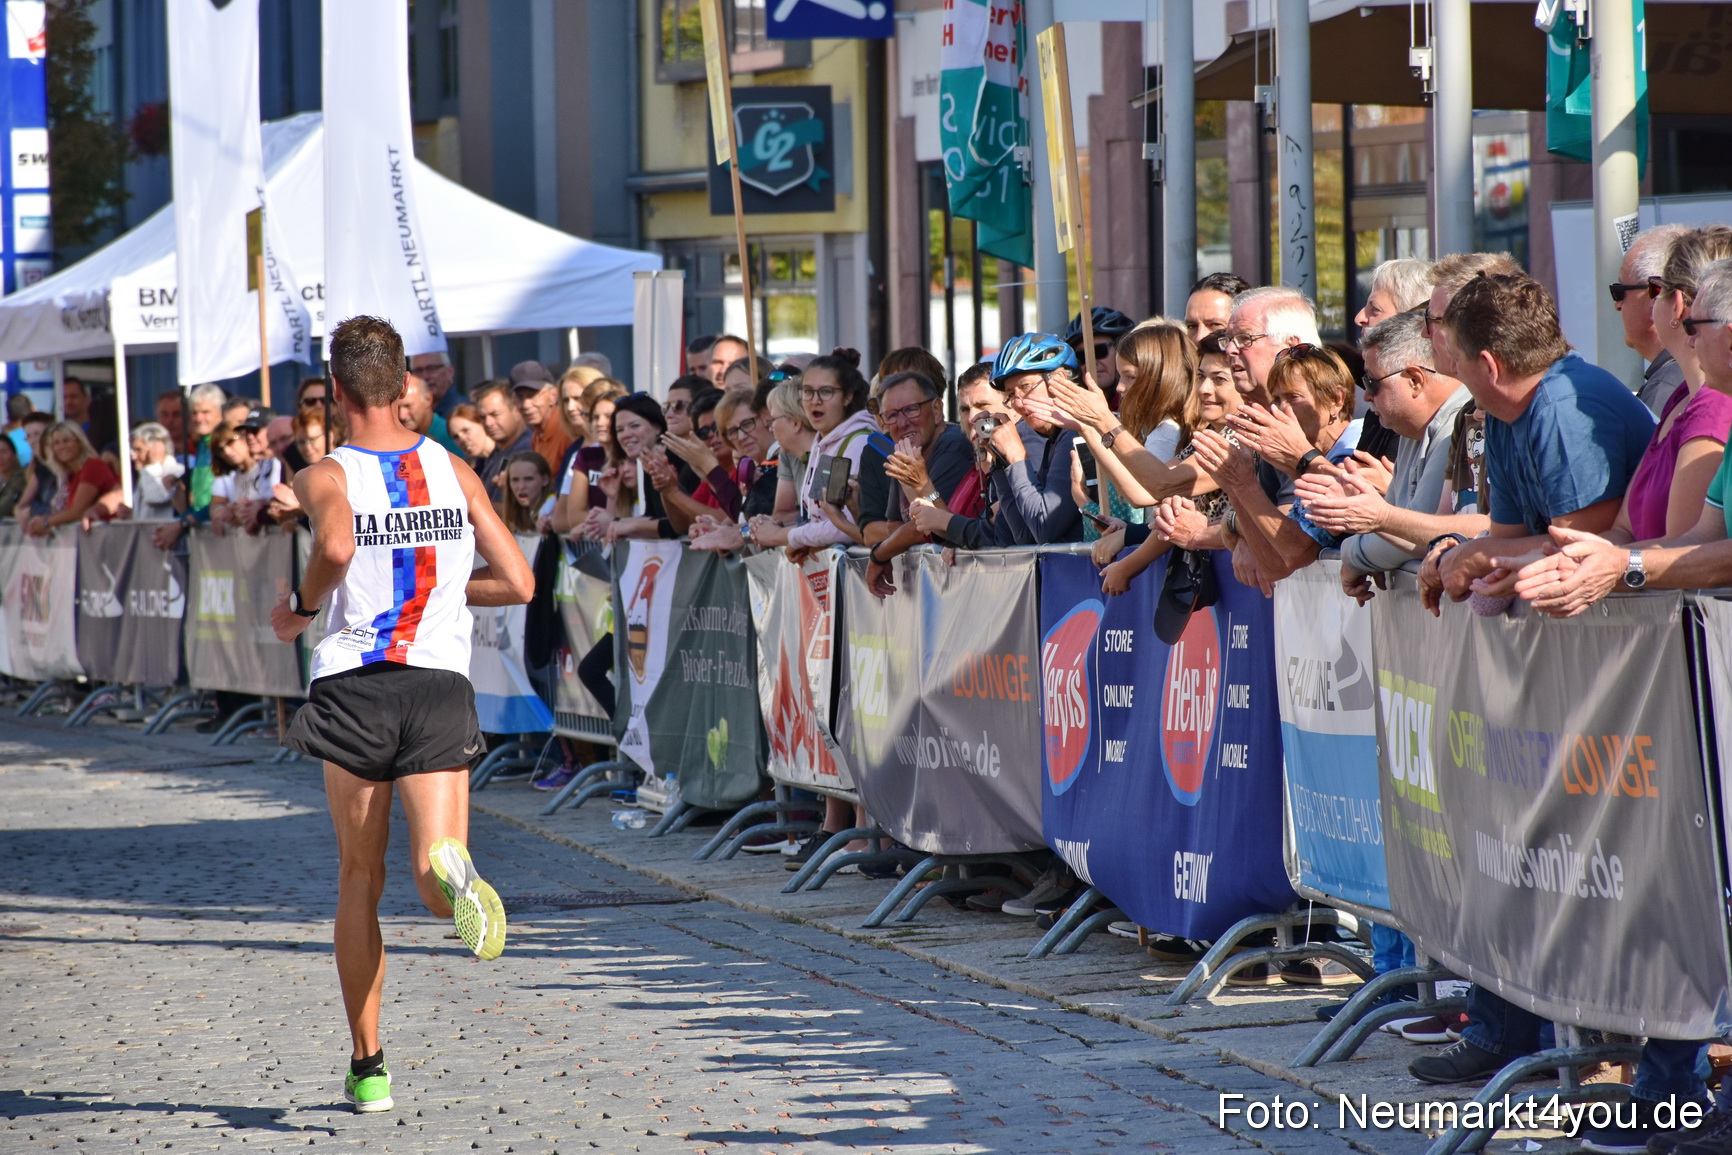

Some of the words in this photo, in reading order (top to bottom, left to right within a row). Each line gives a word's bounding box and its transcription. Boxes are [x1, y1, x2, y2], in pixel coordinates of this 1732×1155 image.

[754, 121, 796, 173] G2
[388, 144, 422, 267] NEUMARKT
[411, 270, 440, 338] PARTL
[354, 514, 378, 535] LA
[384, 508, 464, 533] CARRERA
[355, 532, 411, 547] TRITEAM
[1104, 629, 1134, 653] STORE
[1231, 625, 1249, 649] STORE
[953, 652, 1032, 702] LOUNGE
[1042, 642, 1086, 748] Hervis
[1103, 684, 1134, 708] ONLINE
[1166, 641, 1217, 754] Hervis
[1226, 683, 1250, 709] ONLINE
[1105, 739, 1127, 763] MOBILE
[1221, 743, 1249, 769] MOBILE
